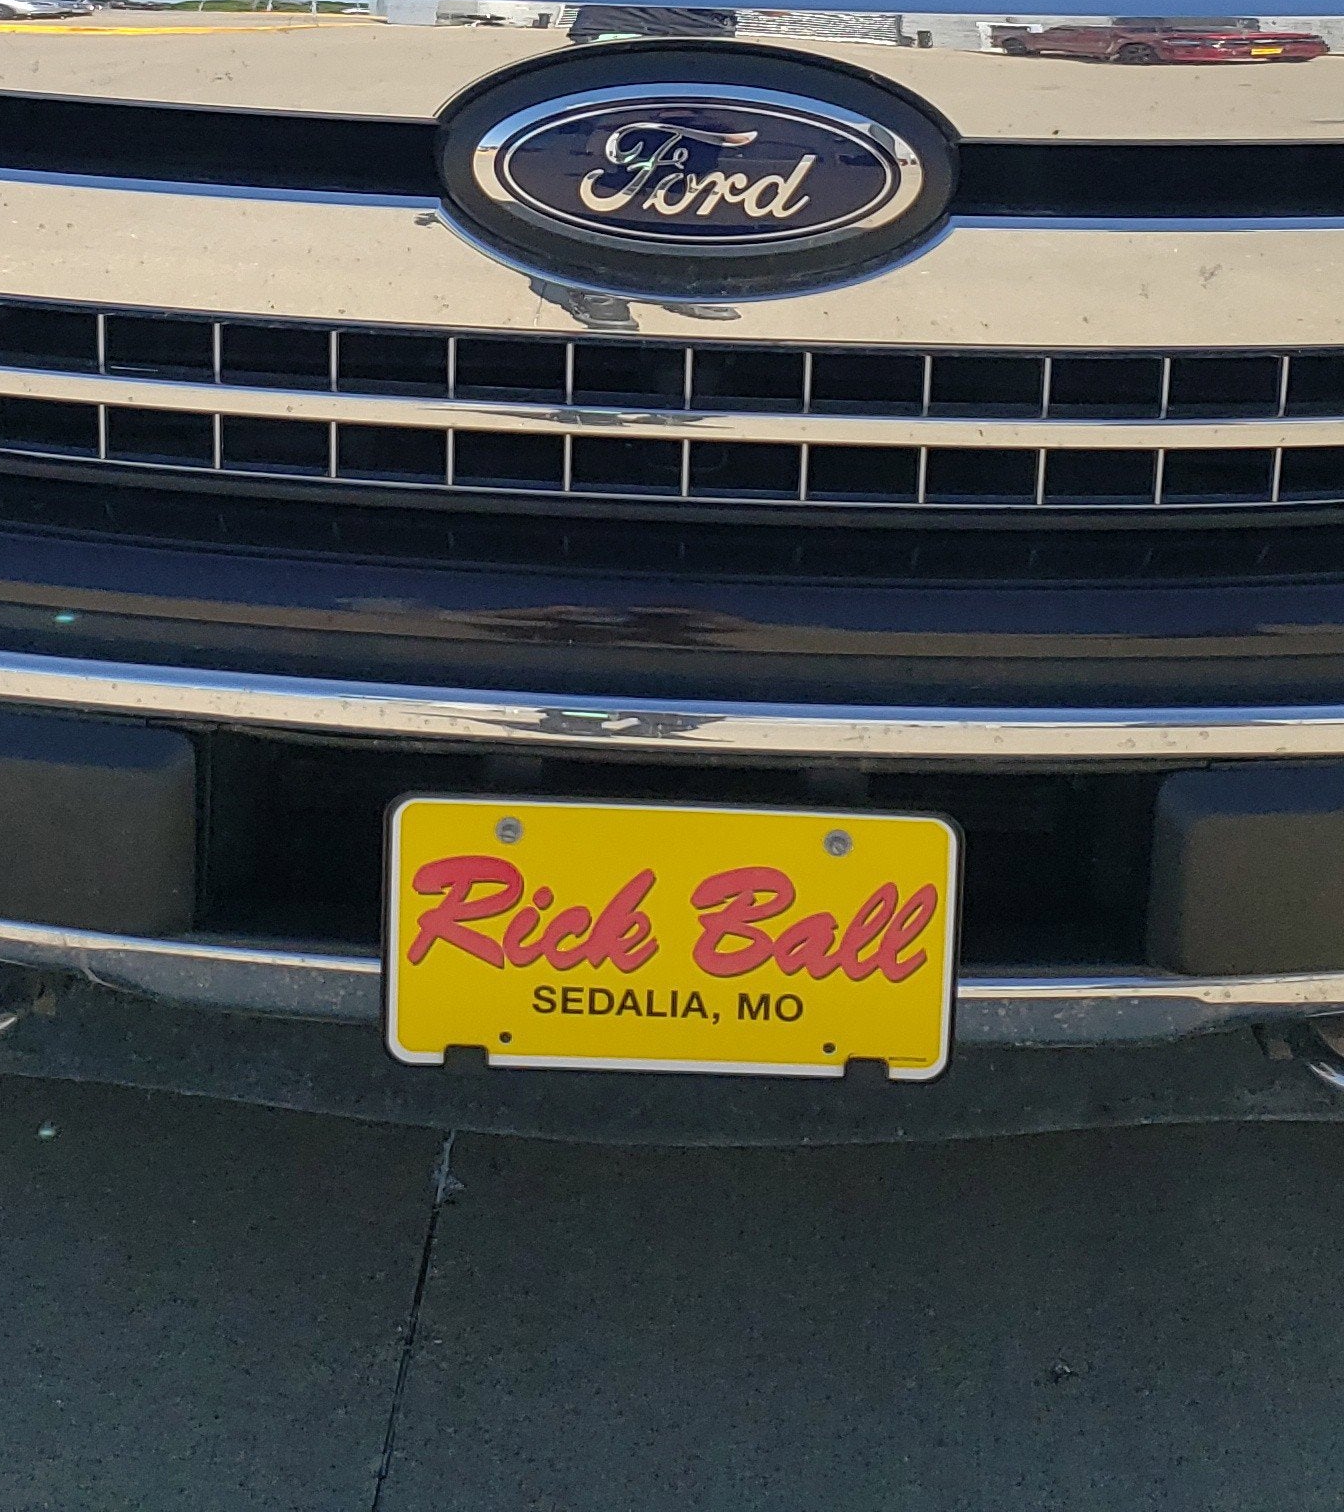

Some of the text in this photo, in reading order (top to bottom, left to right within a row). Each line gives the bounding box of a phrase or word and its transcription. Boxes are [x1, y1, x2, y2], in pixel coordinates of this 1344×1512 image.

[579, 121, 817, 219] Ford
[407, 855, 938, 984] Rick Ball
[532, 985, 805, 1025] SEDALIA, MO
